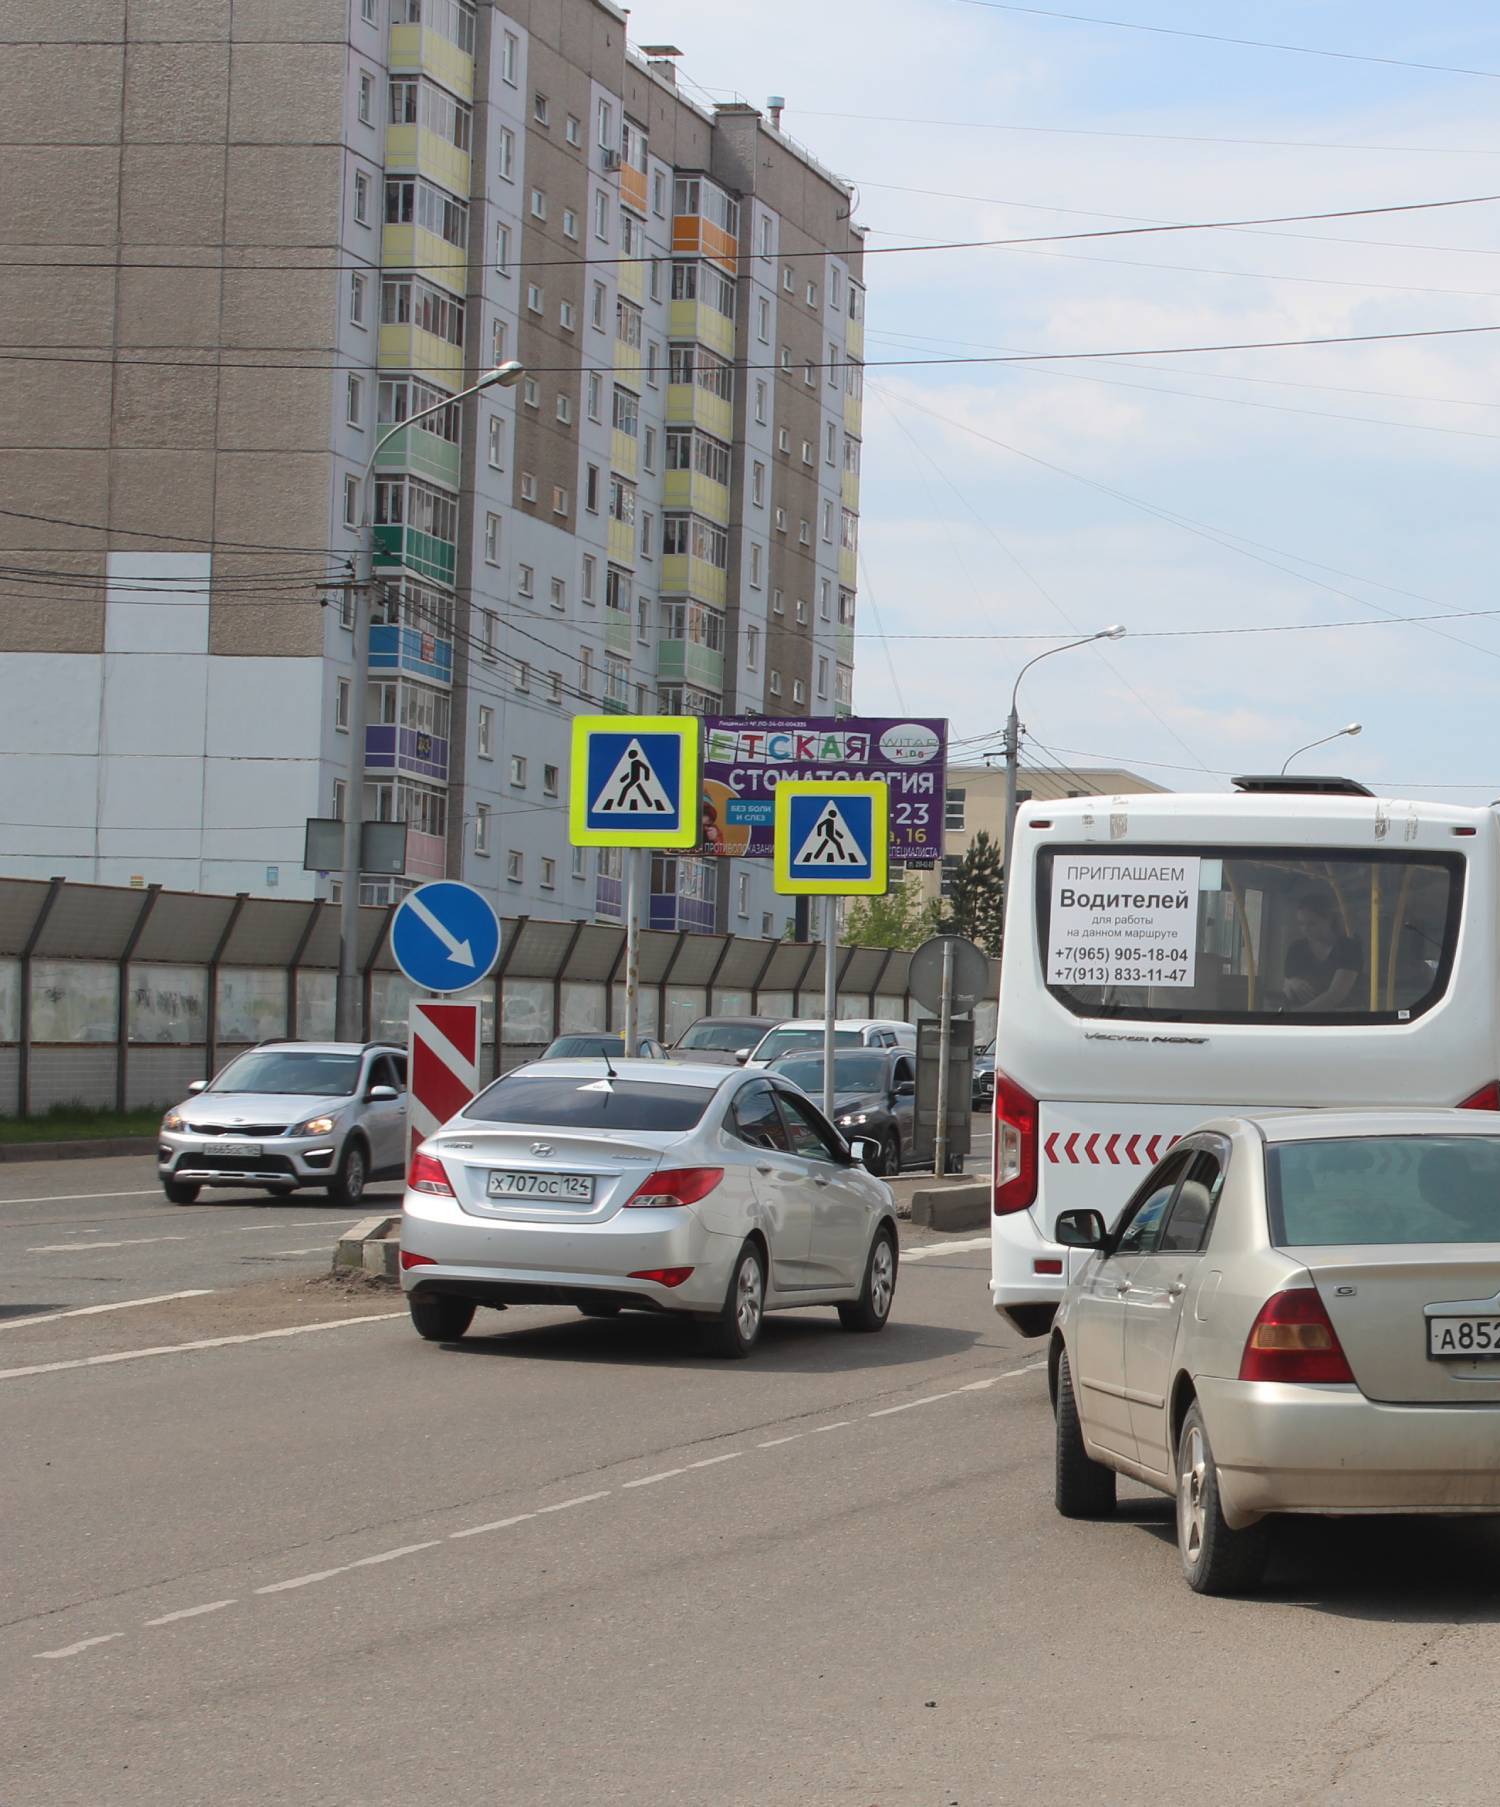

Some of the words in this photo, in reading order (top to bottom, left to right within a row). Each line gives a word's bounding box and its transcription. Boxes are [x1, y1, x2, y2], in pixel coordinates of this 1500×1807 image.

[709, 733, 866, 762] ЕТСКАЯ
[889, 804, 930, 825] -23
[906, 828, 927, 843] 16
[890, 846, 938, 857] ПЕЦИАЛИСТА
[1067, 867, 1185, 881] ПРИГЛАШАЕМ
[1060, 889, 1189, 911] Водителей
[1092, 916, 1112, 925] для
[1114, 915, 1154, 926] работы
[1067, 929, 1080, 937] на
[1082, 930, 1122, 938] данном
[1124, 931, 1178, 940] маршруте
[1056, 947, 1110, 963] +7(965)
[1114, 949, 1188, 961] 905-18-04
[1055, 967, 1110, 983] +7(913)
[1114, 968, 1187, 982] 833-11-47
[563, 1178, 590, 1192] 124
[1337, 1286, 1353, 1295] G
